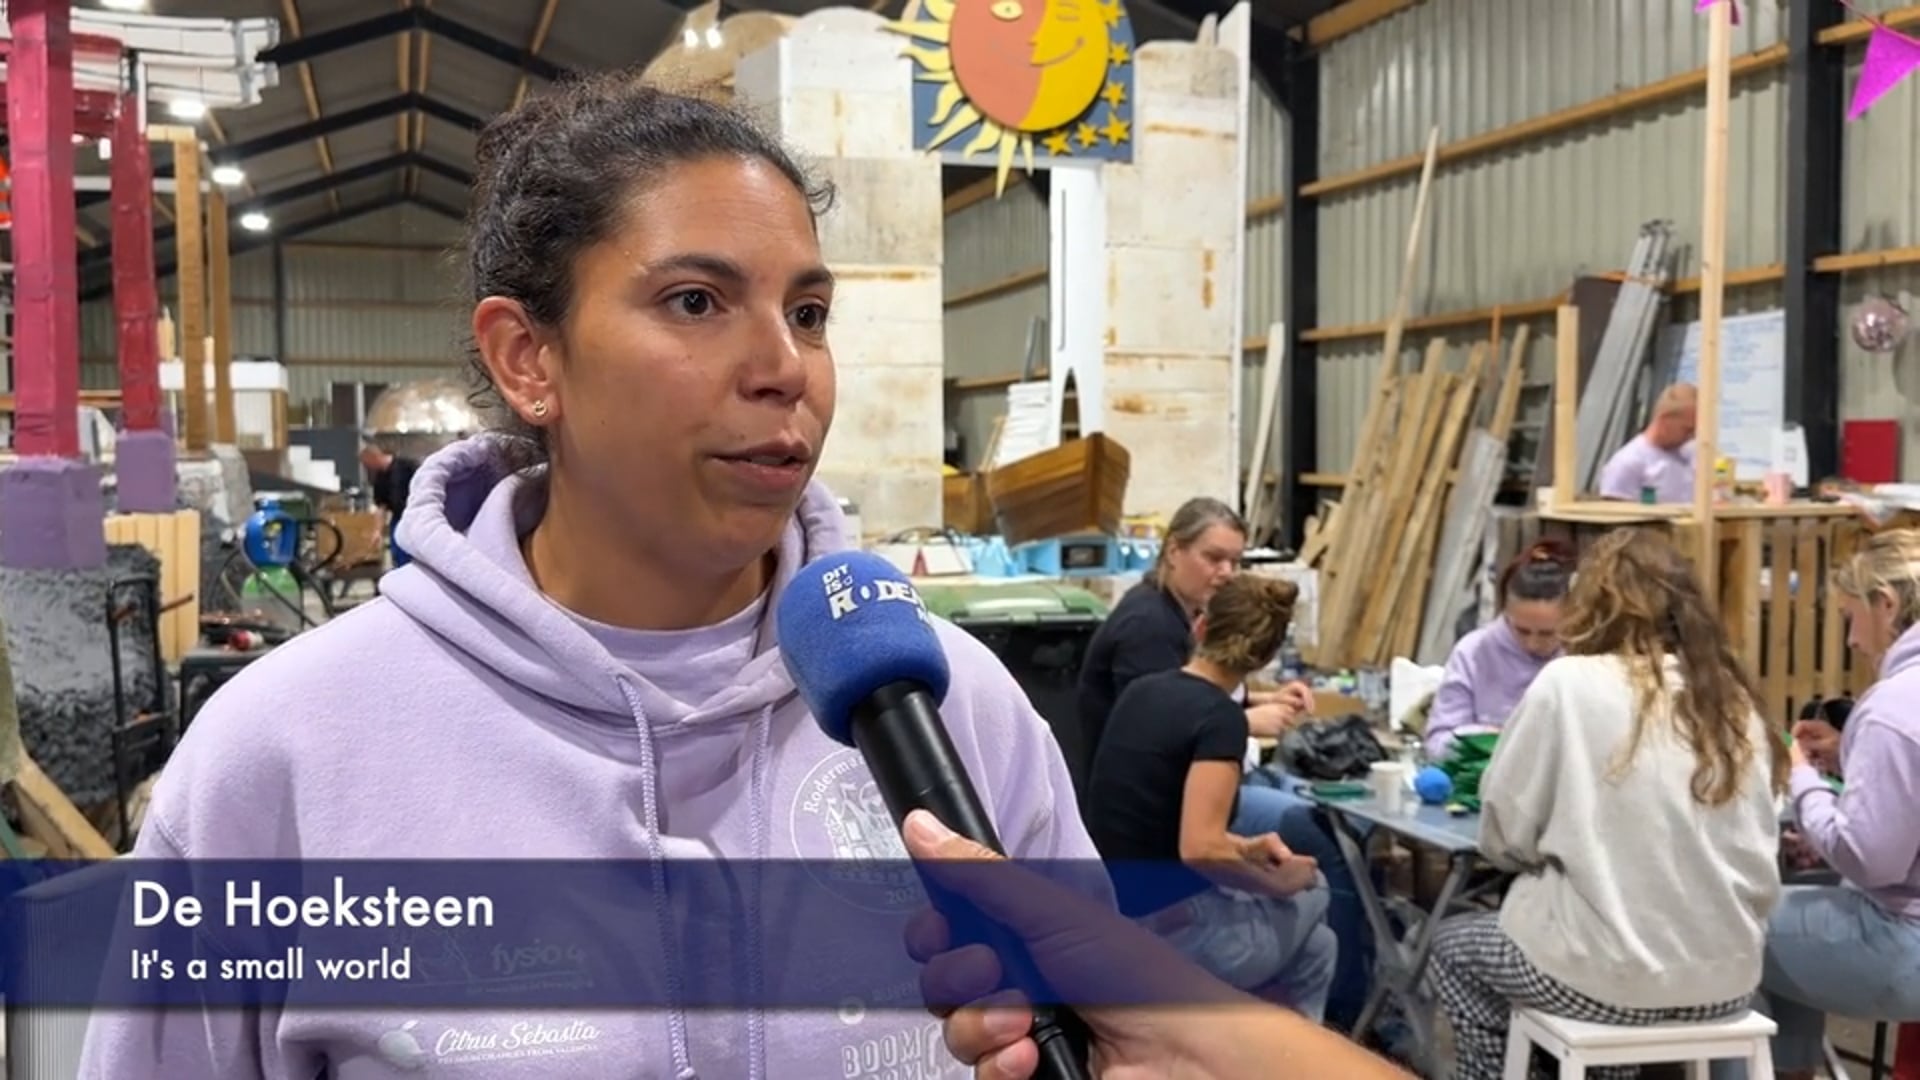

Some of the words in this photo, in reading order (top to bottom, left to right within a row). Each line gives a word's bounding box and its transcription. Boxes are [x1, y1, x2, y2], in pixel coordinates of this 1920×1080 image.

[823, 563, 849, 585] DIT
[803, 754, 865, 814] Rodermar
[434, 1028, 497, 1057] Citrus
[842, 1026, 922, 1079] BOOM
